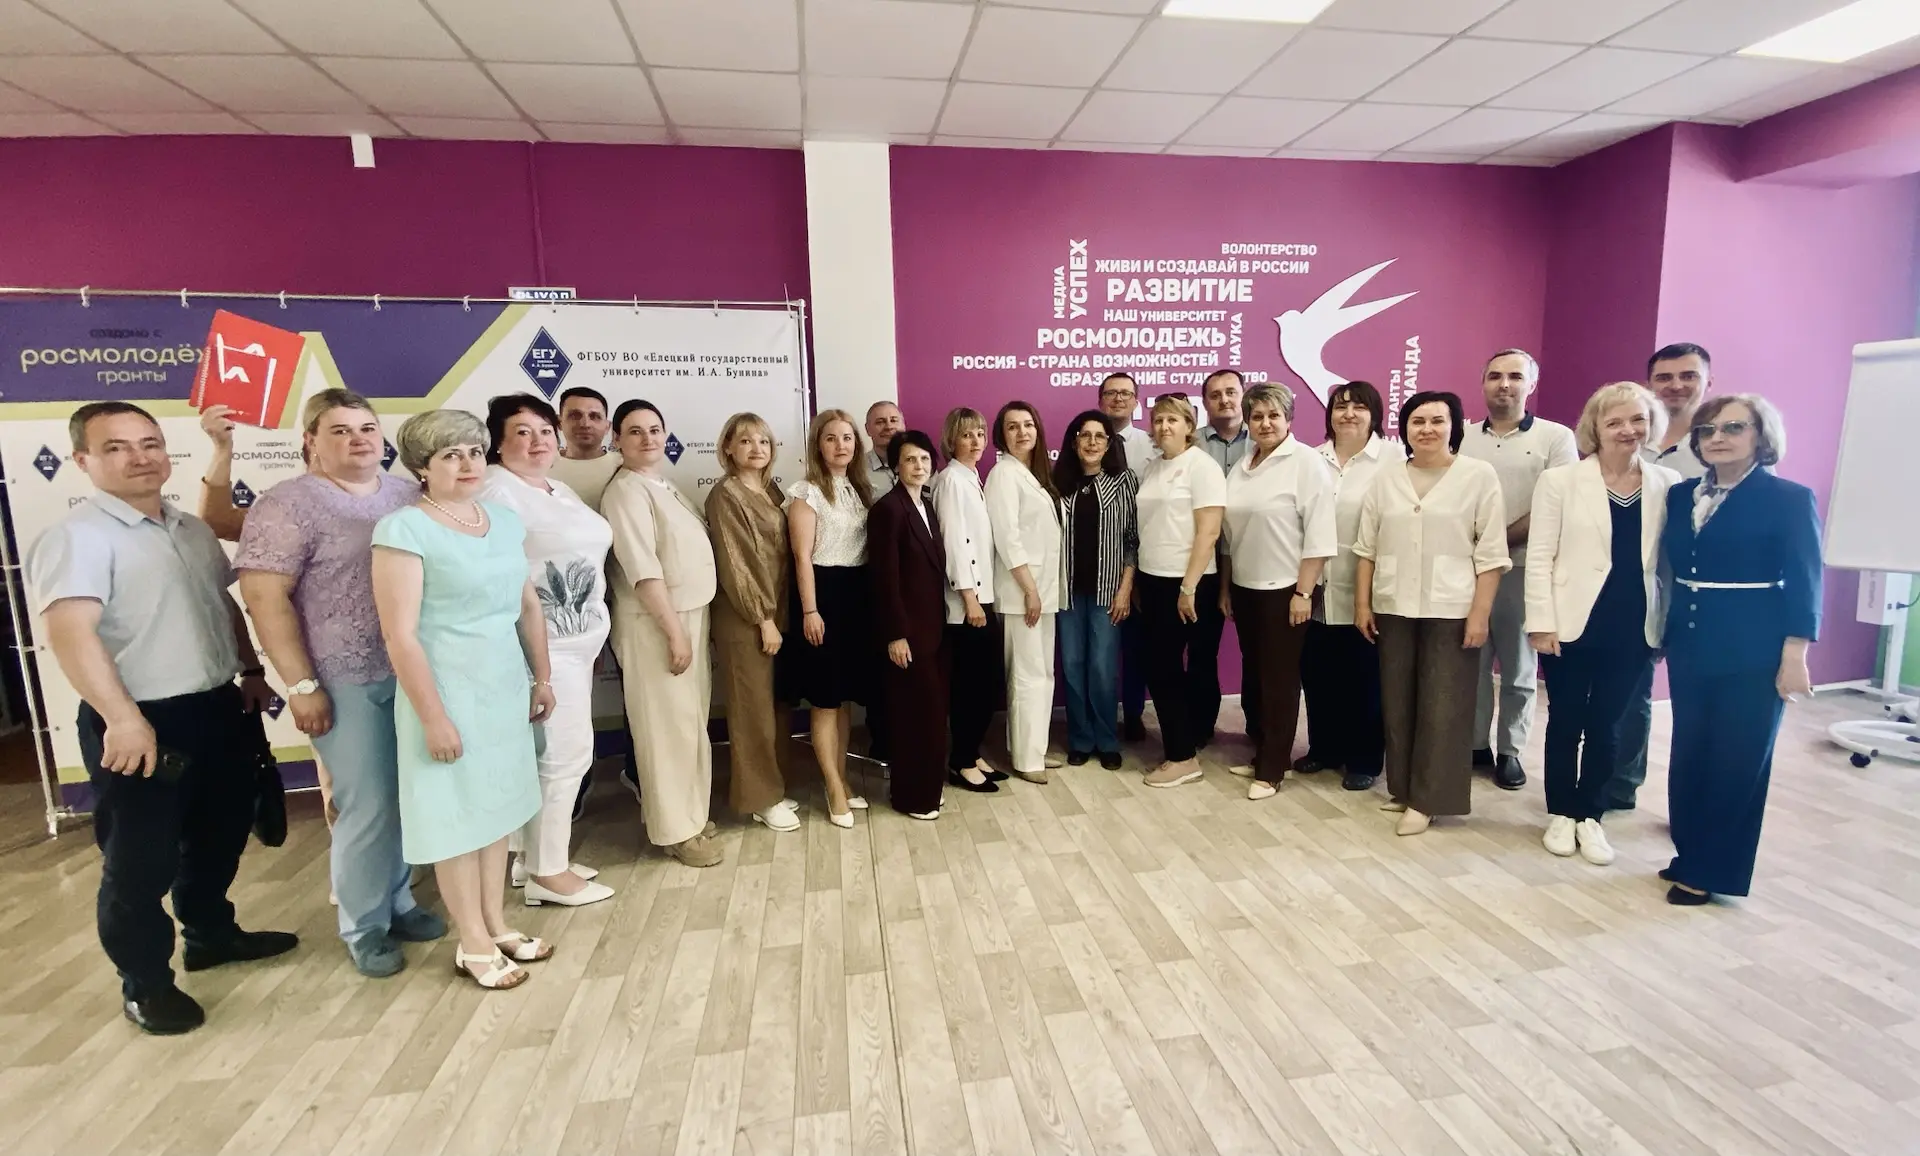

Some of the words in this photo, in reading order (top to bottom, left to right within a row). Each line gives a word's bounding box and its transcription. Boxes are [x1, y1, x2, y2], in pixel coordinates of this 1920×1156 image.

[1221, 243, 1318, 256] ВОЛОНТЕРСТВО
[1094, 259, 1142, 273] ЖИВИ
[1143, 259, 1155, 273] И
[1156, 256, 1237, 275] СОЗДАВАЙ
[1239, 260, 1249, 273] В
[1251, 260, 1310, 274] РОССИИ
[1069, 238, 1088, 320] УСПЕХ
[1053, 265, 1067, 319] МЕДИА
[1106, 278, 1254, 303] РАЗВИТИЕ
[1103, 309, 1138, 322] НАШ
[1140, 310, 1227, 322] УНИВЕРСИТЕТ
[1037, 327, 1226, 351] РОСМОЛОДЕЖЬ
[1229, 312, 1243, 366] НАУКА
[20, 343, 204, 373] росмолодё
[532, 348, 557, 359] ЕГУ
[577, 351, 617, 362] ФГБОУ
[623, 352, 639, 362] ВО
[643, 353, 696, 365] «Елецкий
[700, 355, 789, 365] государственный
[952, 355, 1017, 370] РОССИЯ
[1028, 354, 1090, 369] СТРАНА
[1092, 350, 1219, 369] ВОЗМОЖНОСТЕЙ
[96, 370, 167, 386] гранты
[602, 368, 672, 378] университет
[676, 369, 694, 377] им.
[726, 368, 769, 379] Бунина»
[1050, 370, 1167, 387] ОБРАЗНИЕ
[1169, 371, 1268, 387] СТУДТВО
[1402, 335, 1421, 405] МАНДА
[1387, 369, 1401, 430] ГРАНТЫ
[231, 450, 305, 462] осмолод
